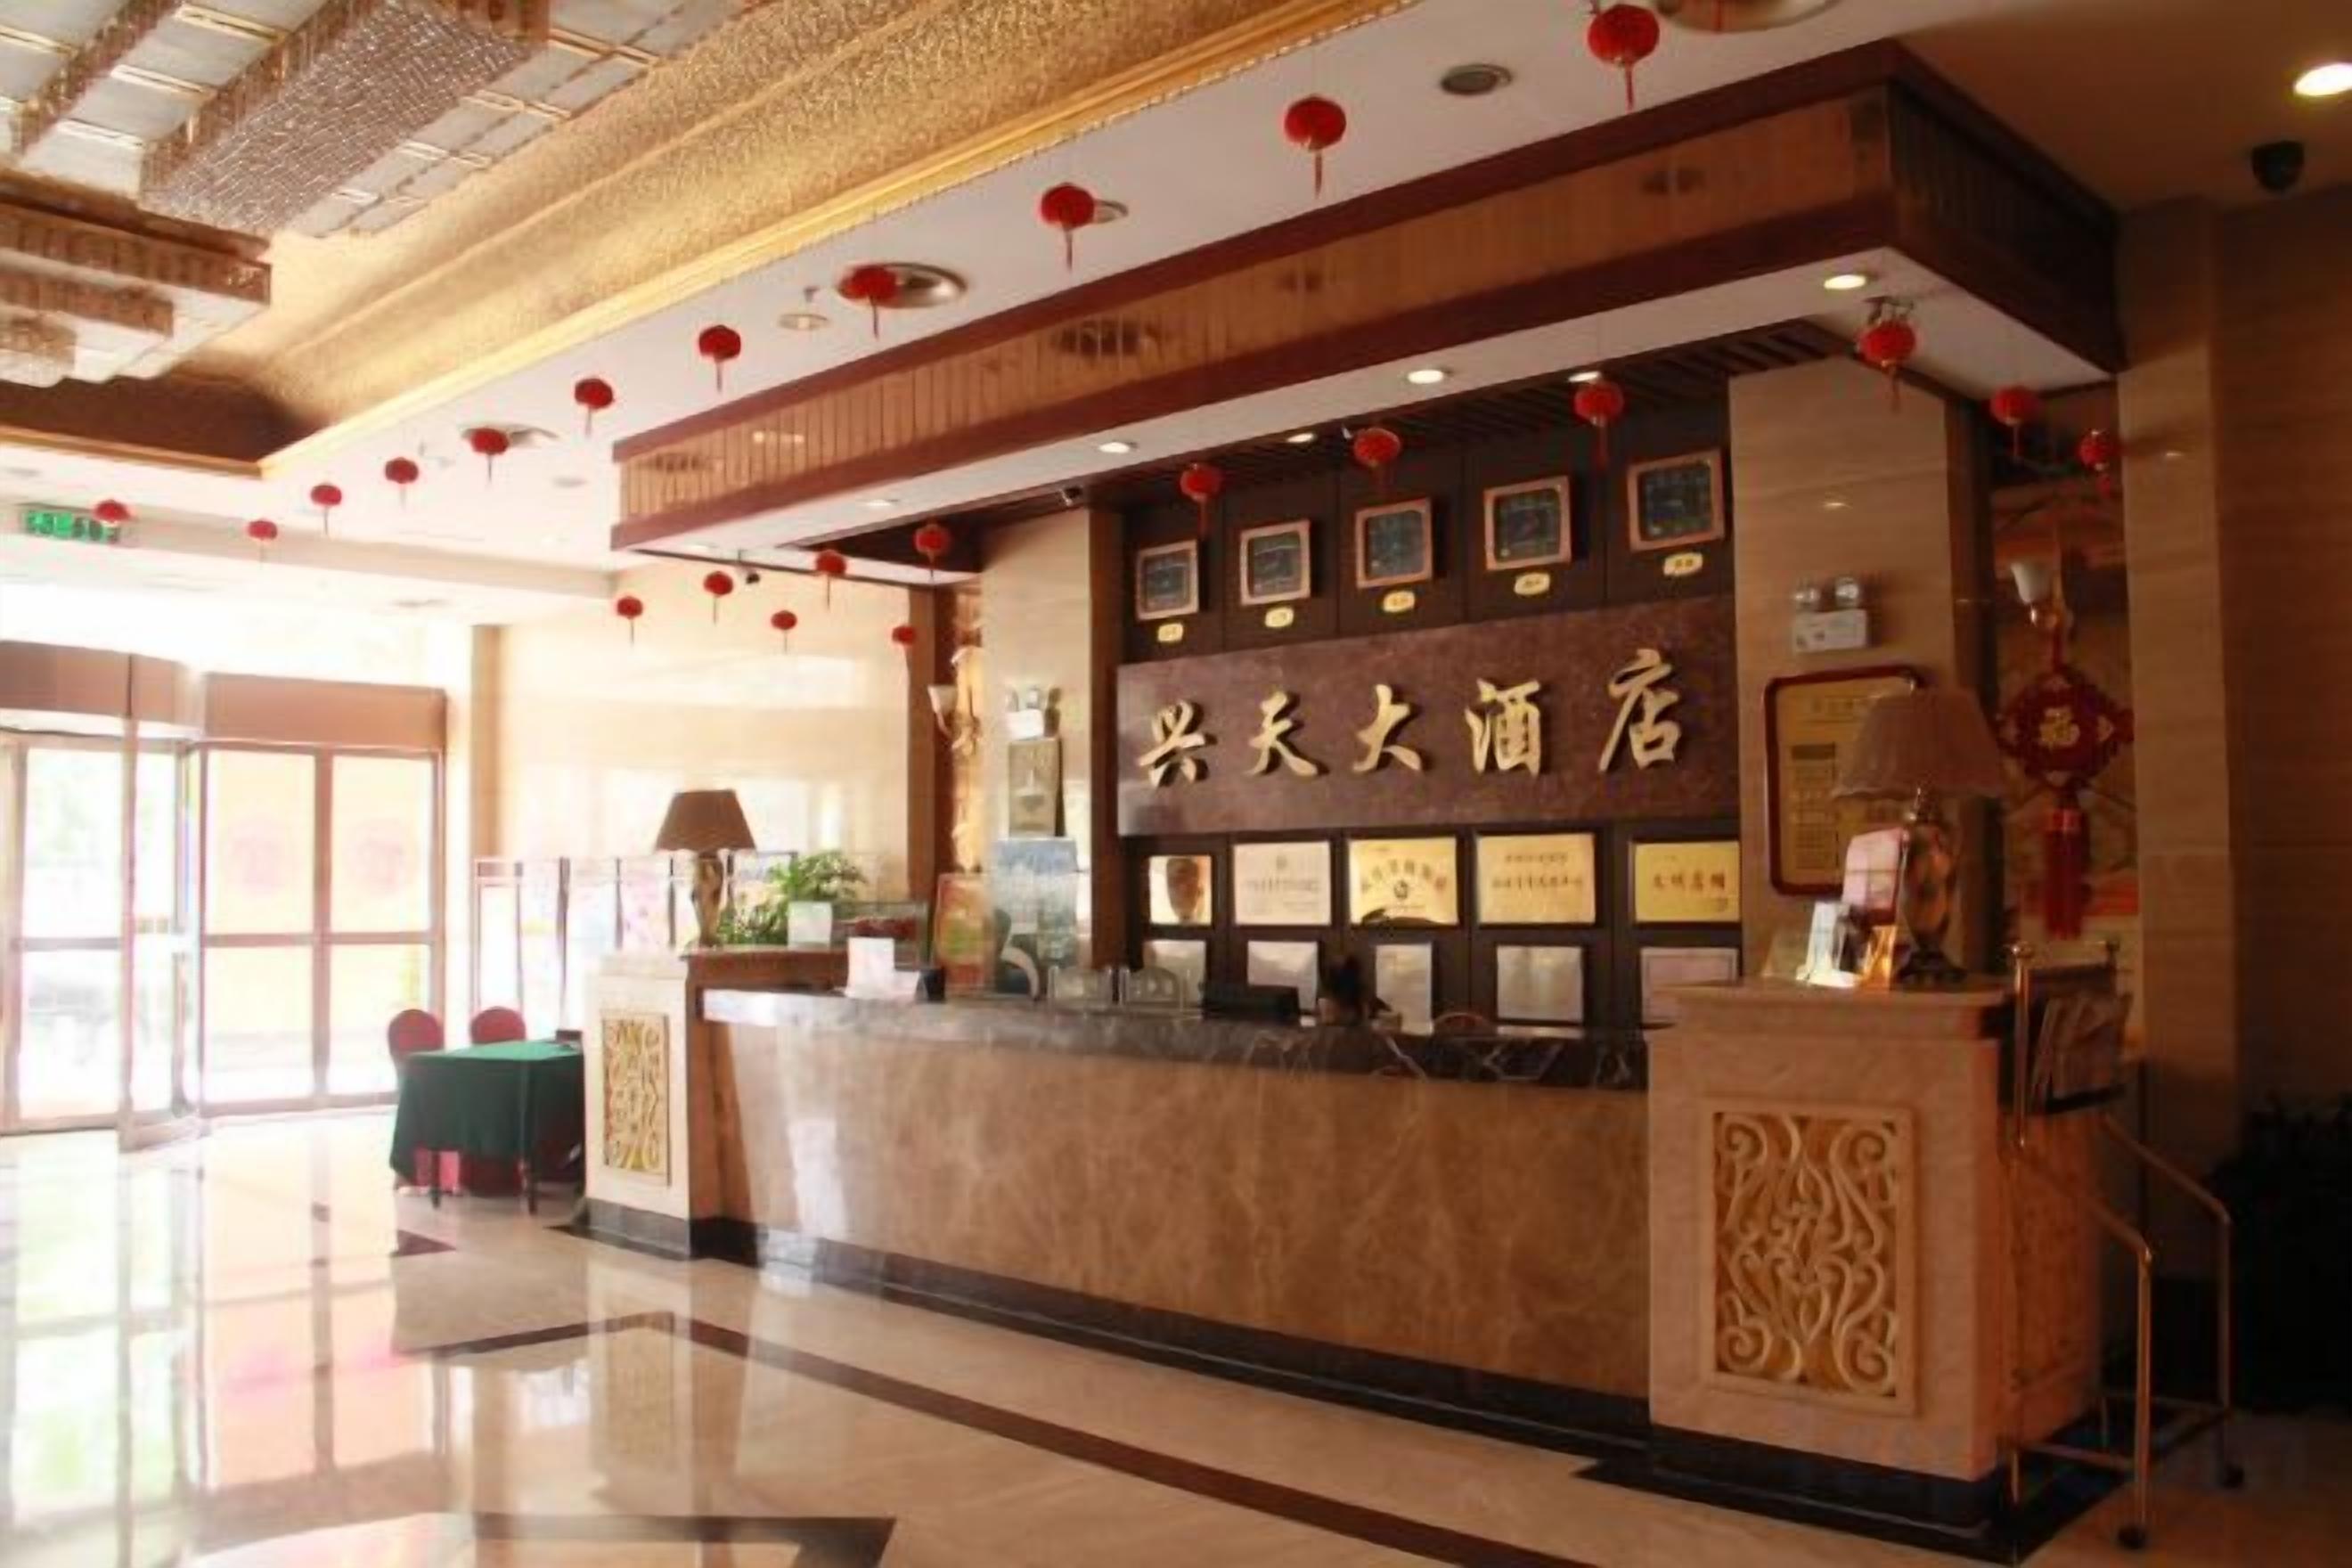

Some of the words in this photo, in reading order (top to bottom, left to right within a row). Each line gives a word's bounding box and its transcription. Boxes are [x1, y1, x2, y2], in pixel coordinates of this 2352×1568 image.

[1138, 648, 1680, 787] 兴天大酒店
